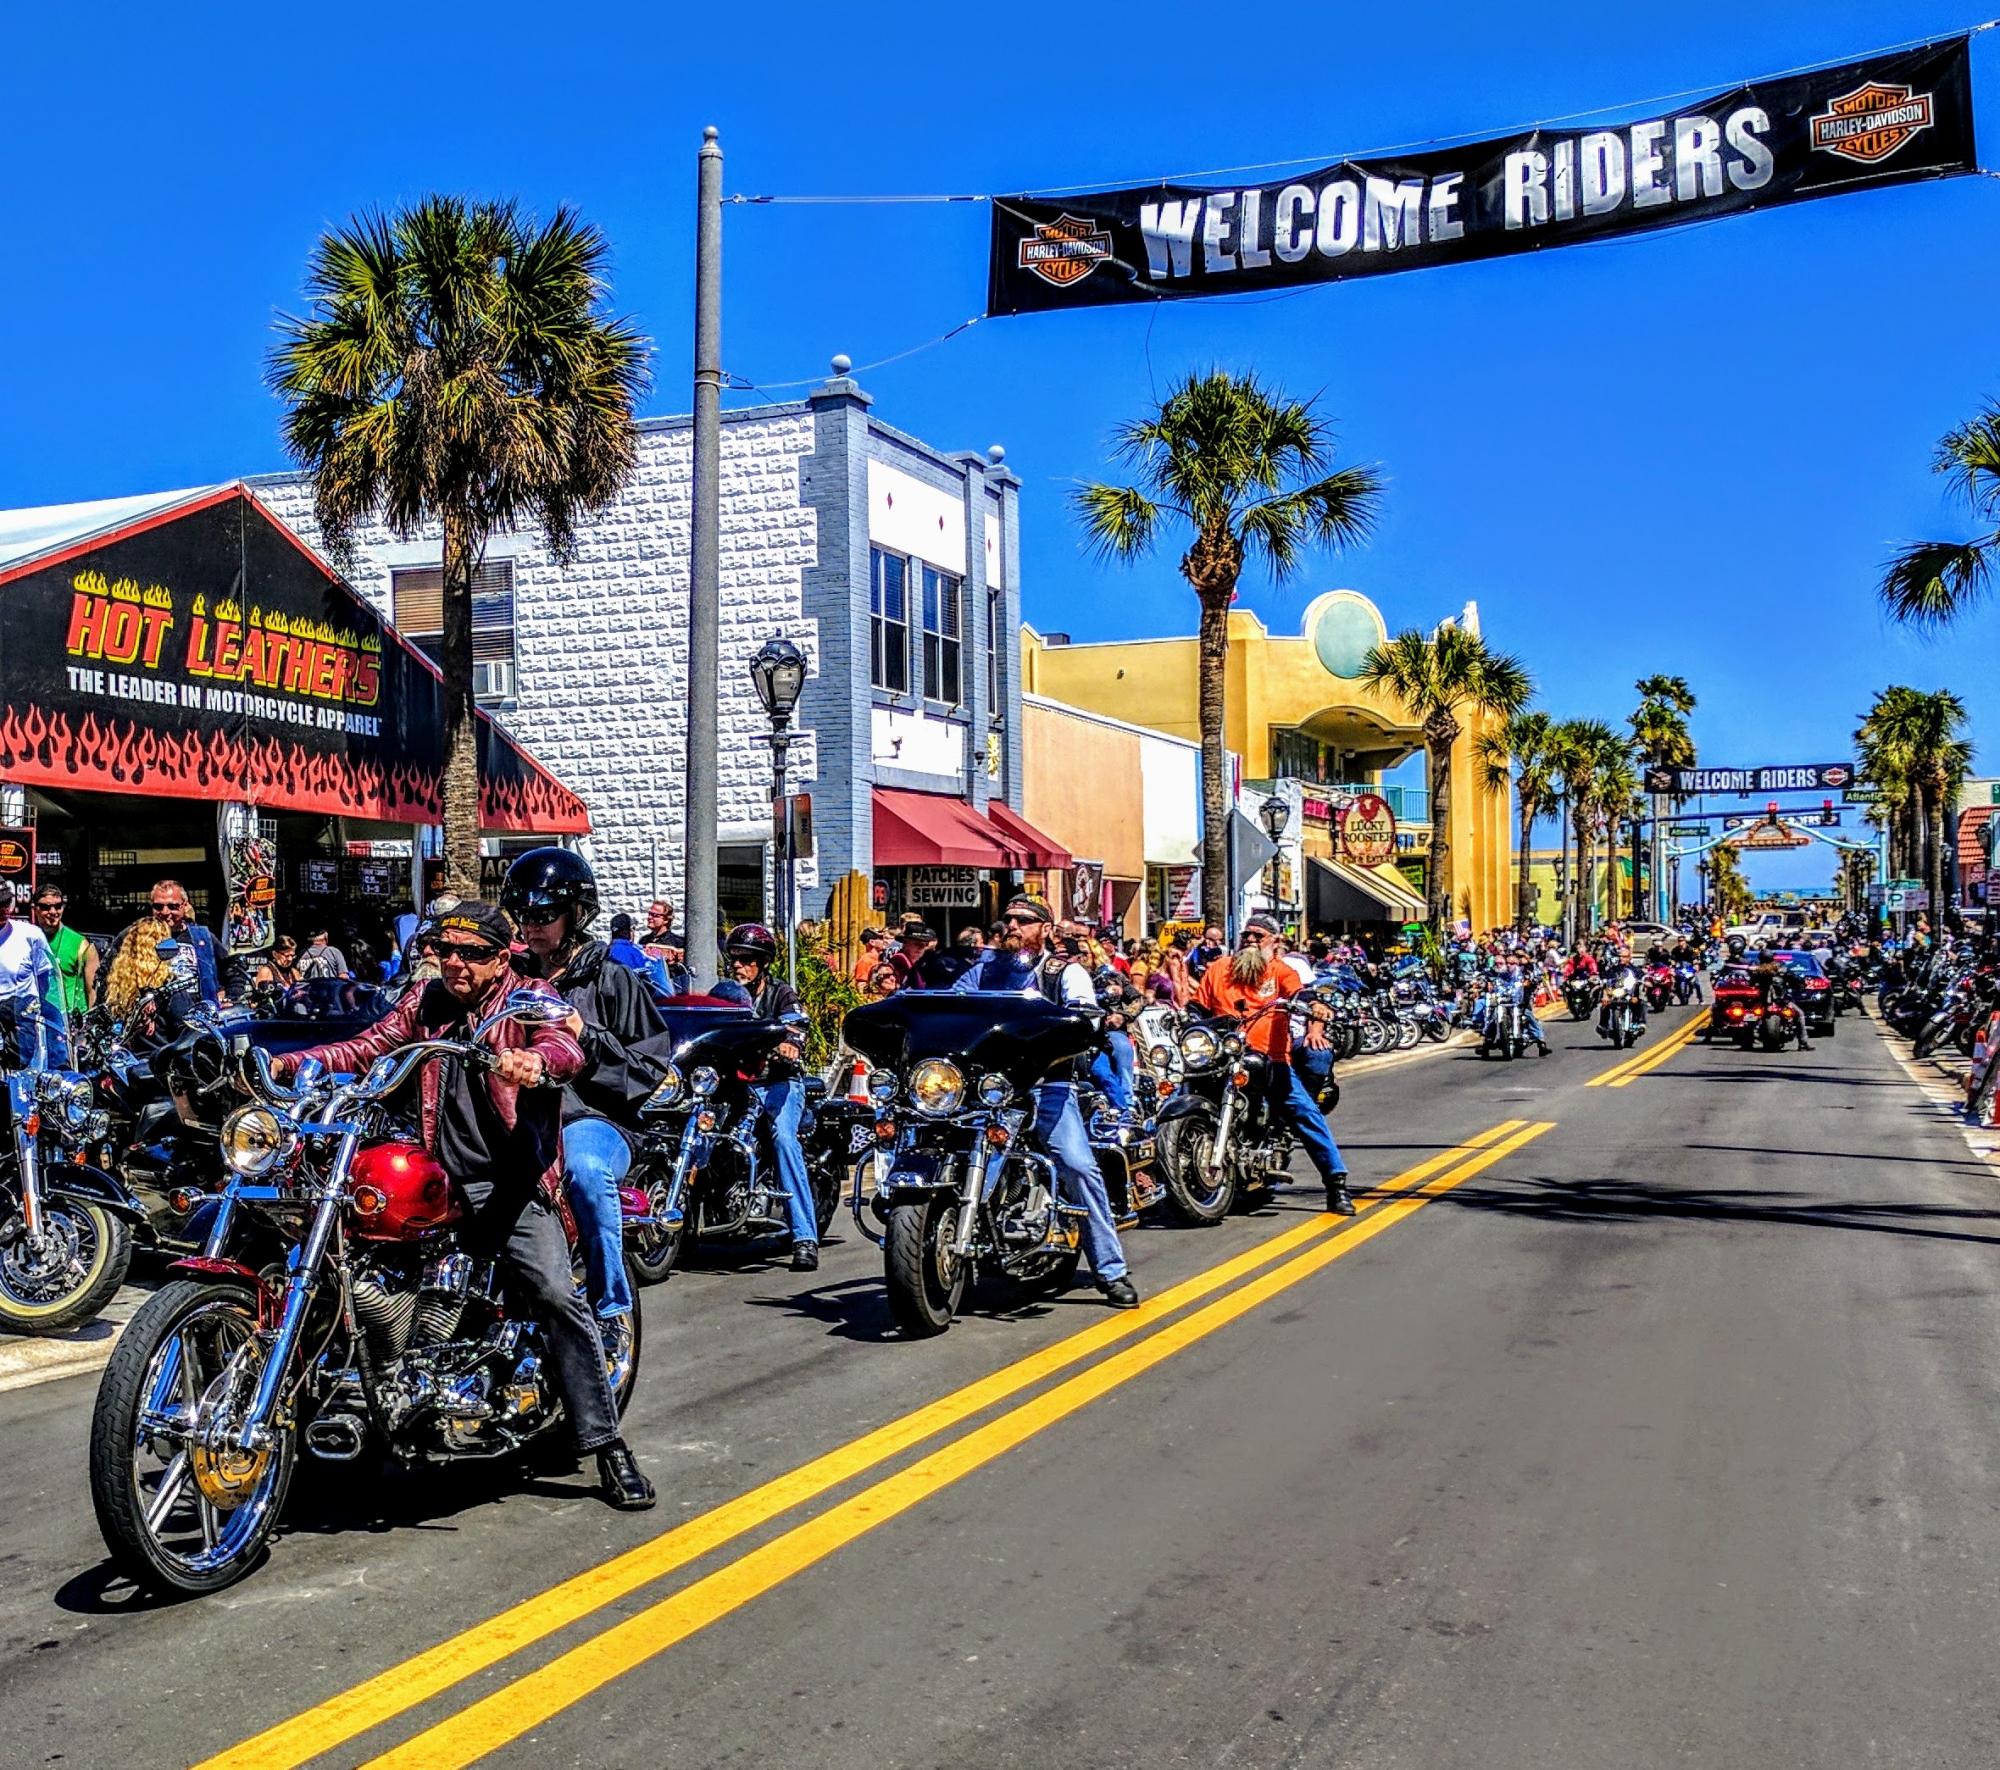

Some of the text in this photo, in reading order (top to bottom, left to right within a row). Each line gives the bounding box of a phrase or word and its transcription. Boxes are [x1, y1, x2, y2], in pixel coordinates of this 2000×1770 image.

[1843, 91, 1898, 113] MOTOR
[1821, 103, 1923, 140] HARLEY-DAVIDSON
[1844, 128, 1900, 155] CYCLES
[1140, 107, 1774, 280] WELCOME RIDERS
[1045, 224, 1088, 239] MOTOR
[1026, 240, 1106, 260] HARLEY-DAVIDSON
[1043, 259, 1087, 278] CYCLES
[66, 593, 382, 706] HOT LEATHERS
[66, 666, 104, 695] THE
[108, 673, 177, 706] LEADER
[180, 684, 200, 710] IN
[206, 688, 314, 726] MOTORCYCLE
[1680, 768, 1818, 790] WELCOME RIDERS
[1846, 790, 1883, 802] Atlantic
[1350, 821, 1385, 832] LUCKY
[1342, 831, 1395, 844] ROOSTER
[911, 867, 976, 883] PATCHES
[911, 887, 976, 903] SEWING
